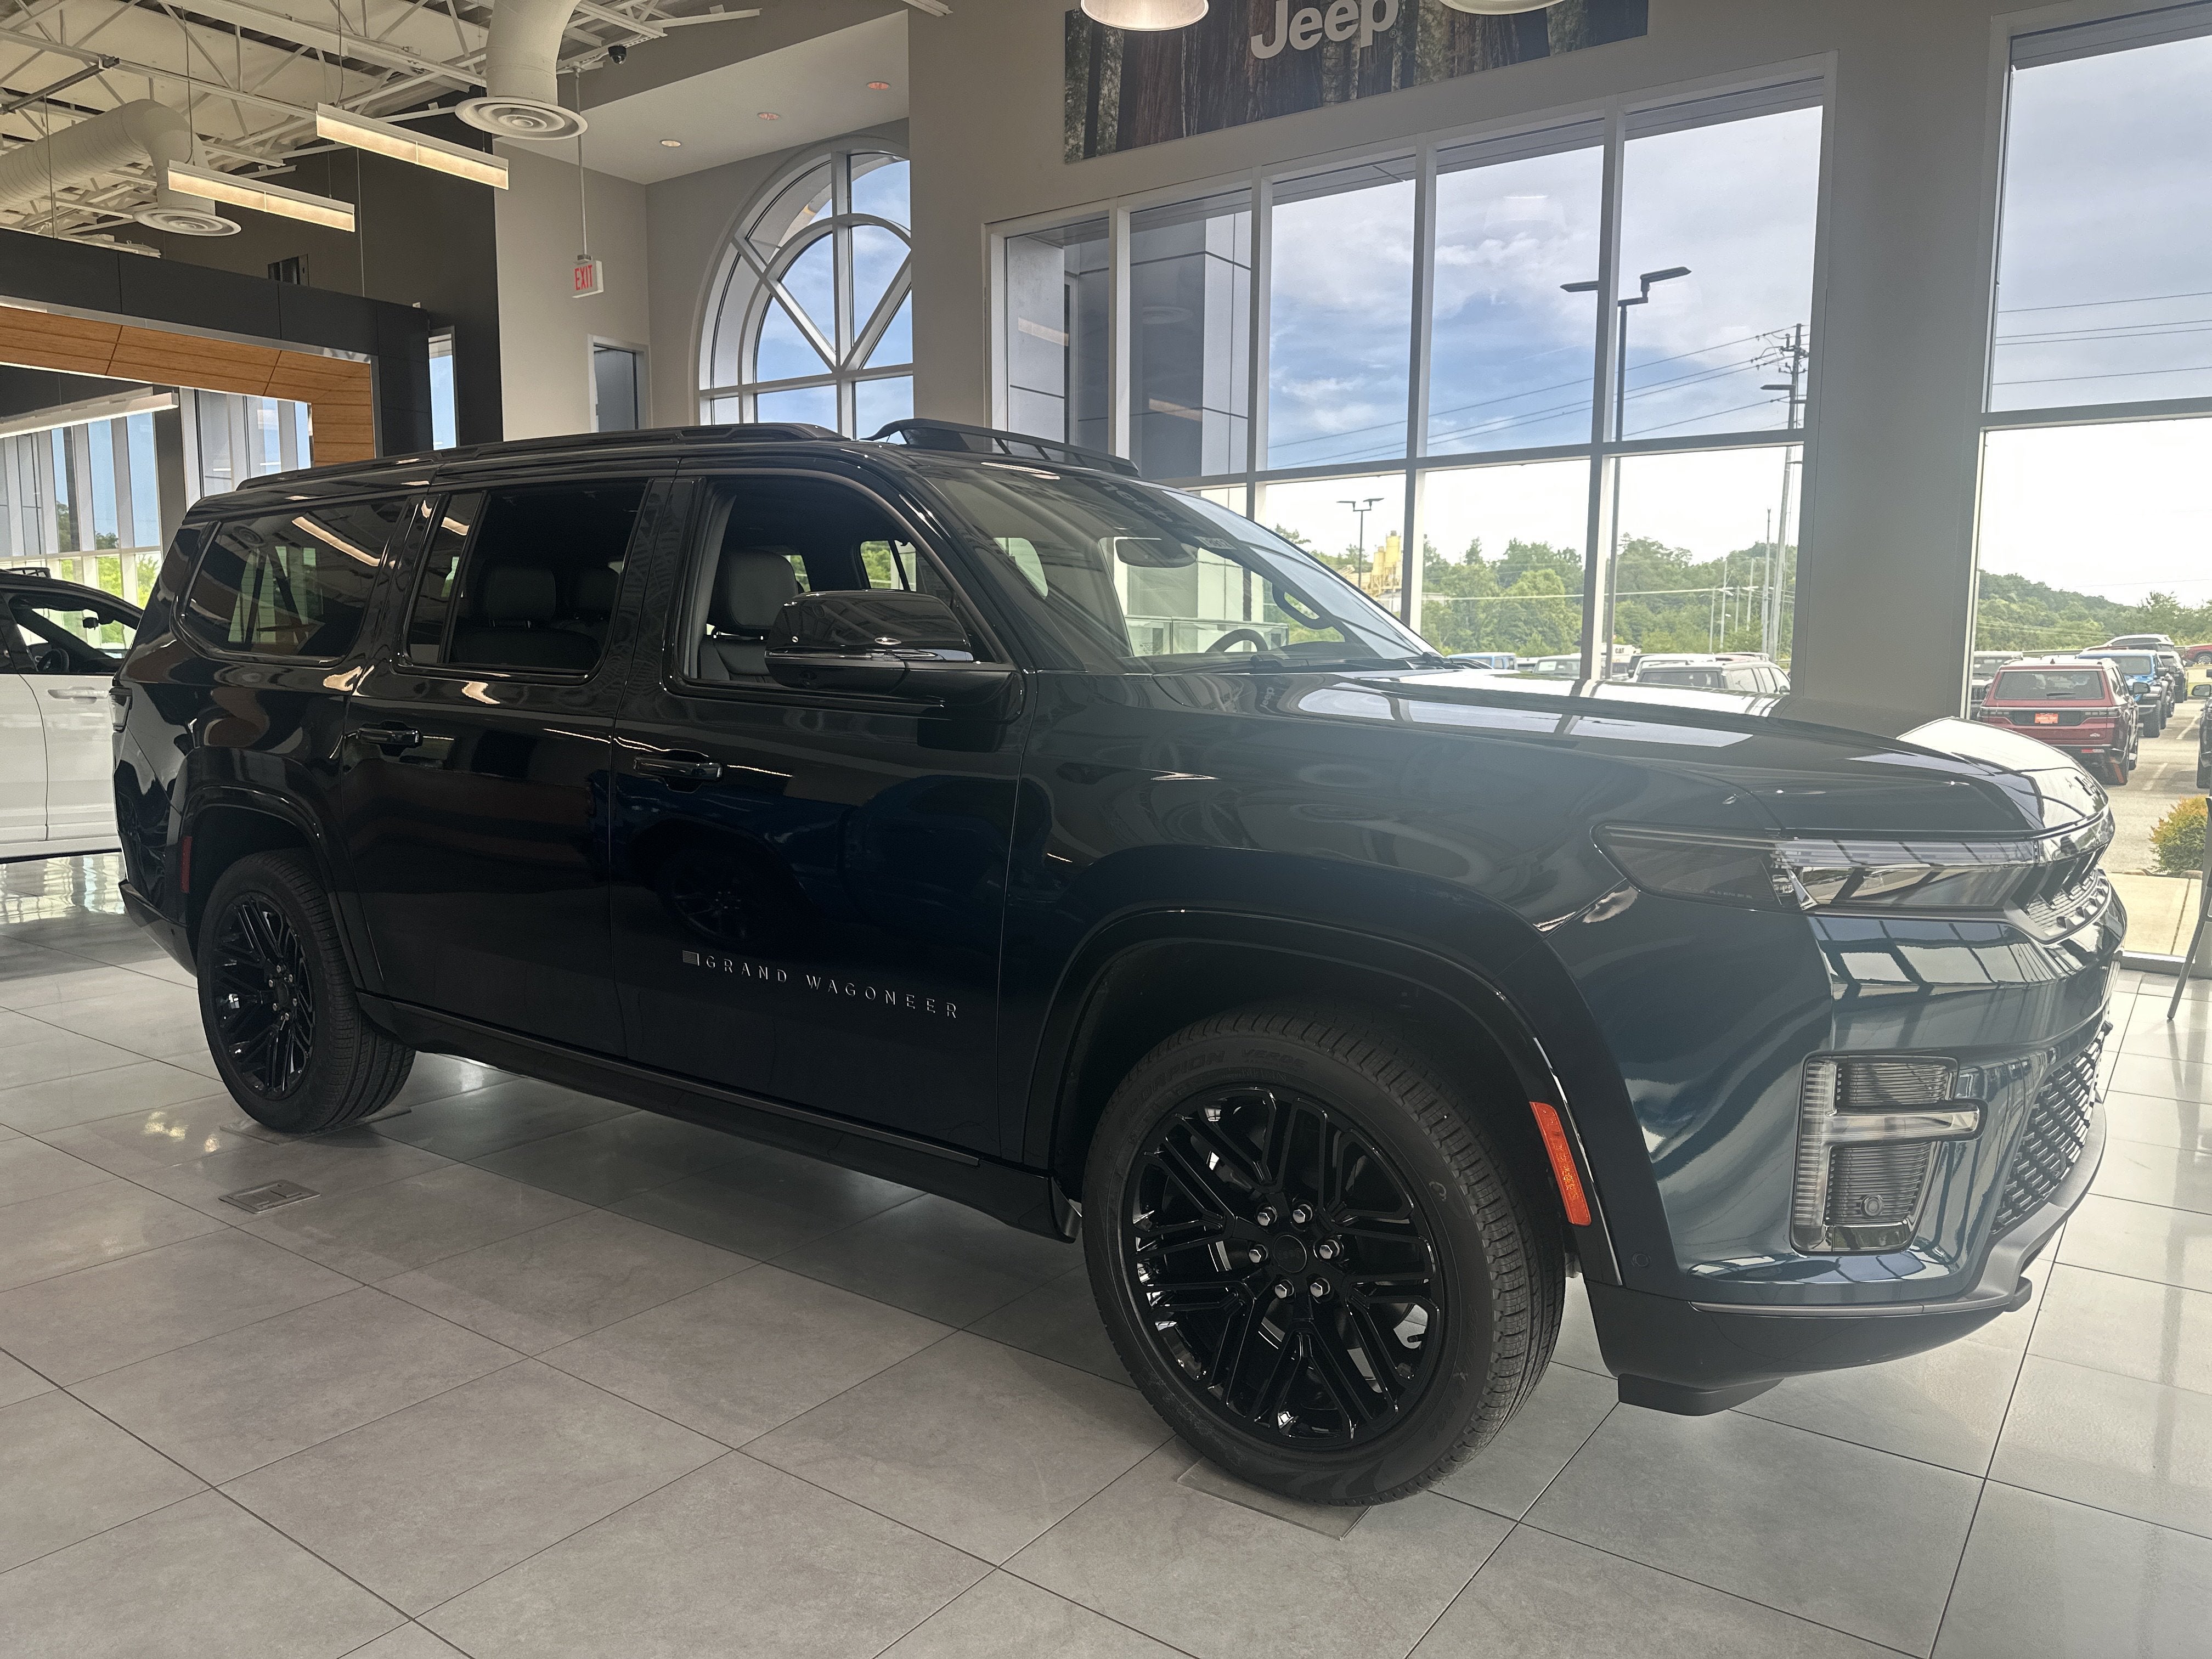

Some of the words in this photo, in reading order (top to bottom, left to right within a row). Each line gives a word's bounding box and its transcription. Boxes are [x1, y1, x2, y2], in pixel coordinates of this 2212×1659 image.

[1251, 0, 1399, 59] Jeep
[574, 264, 592, 290] EXIT
[706, 955, 787, 983] GRAND
[806, 974, 957, 1019] WAGONEER
